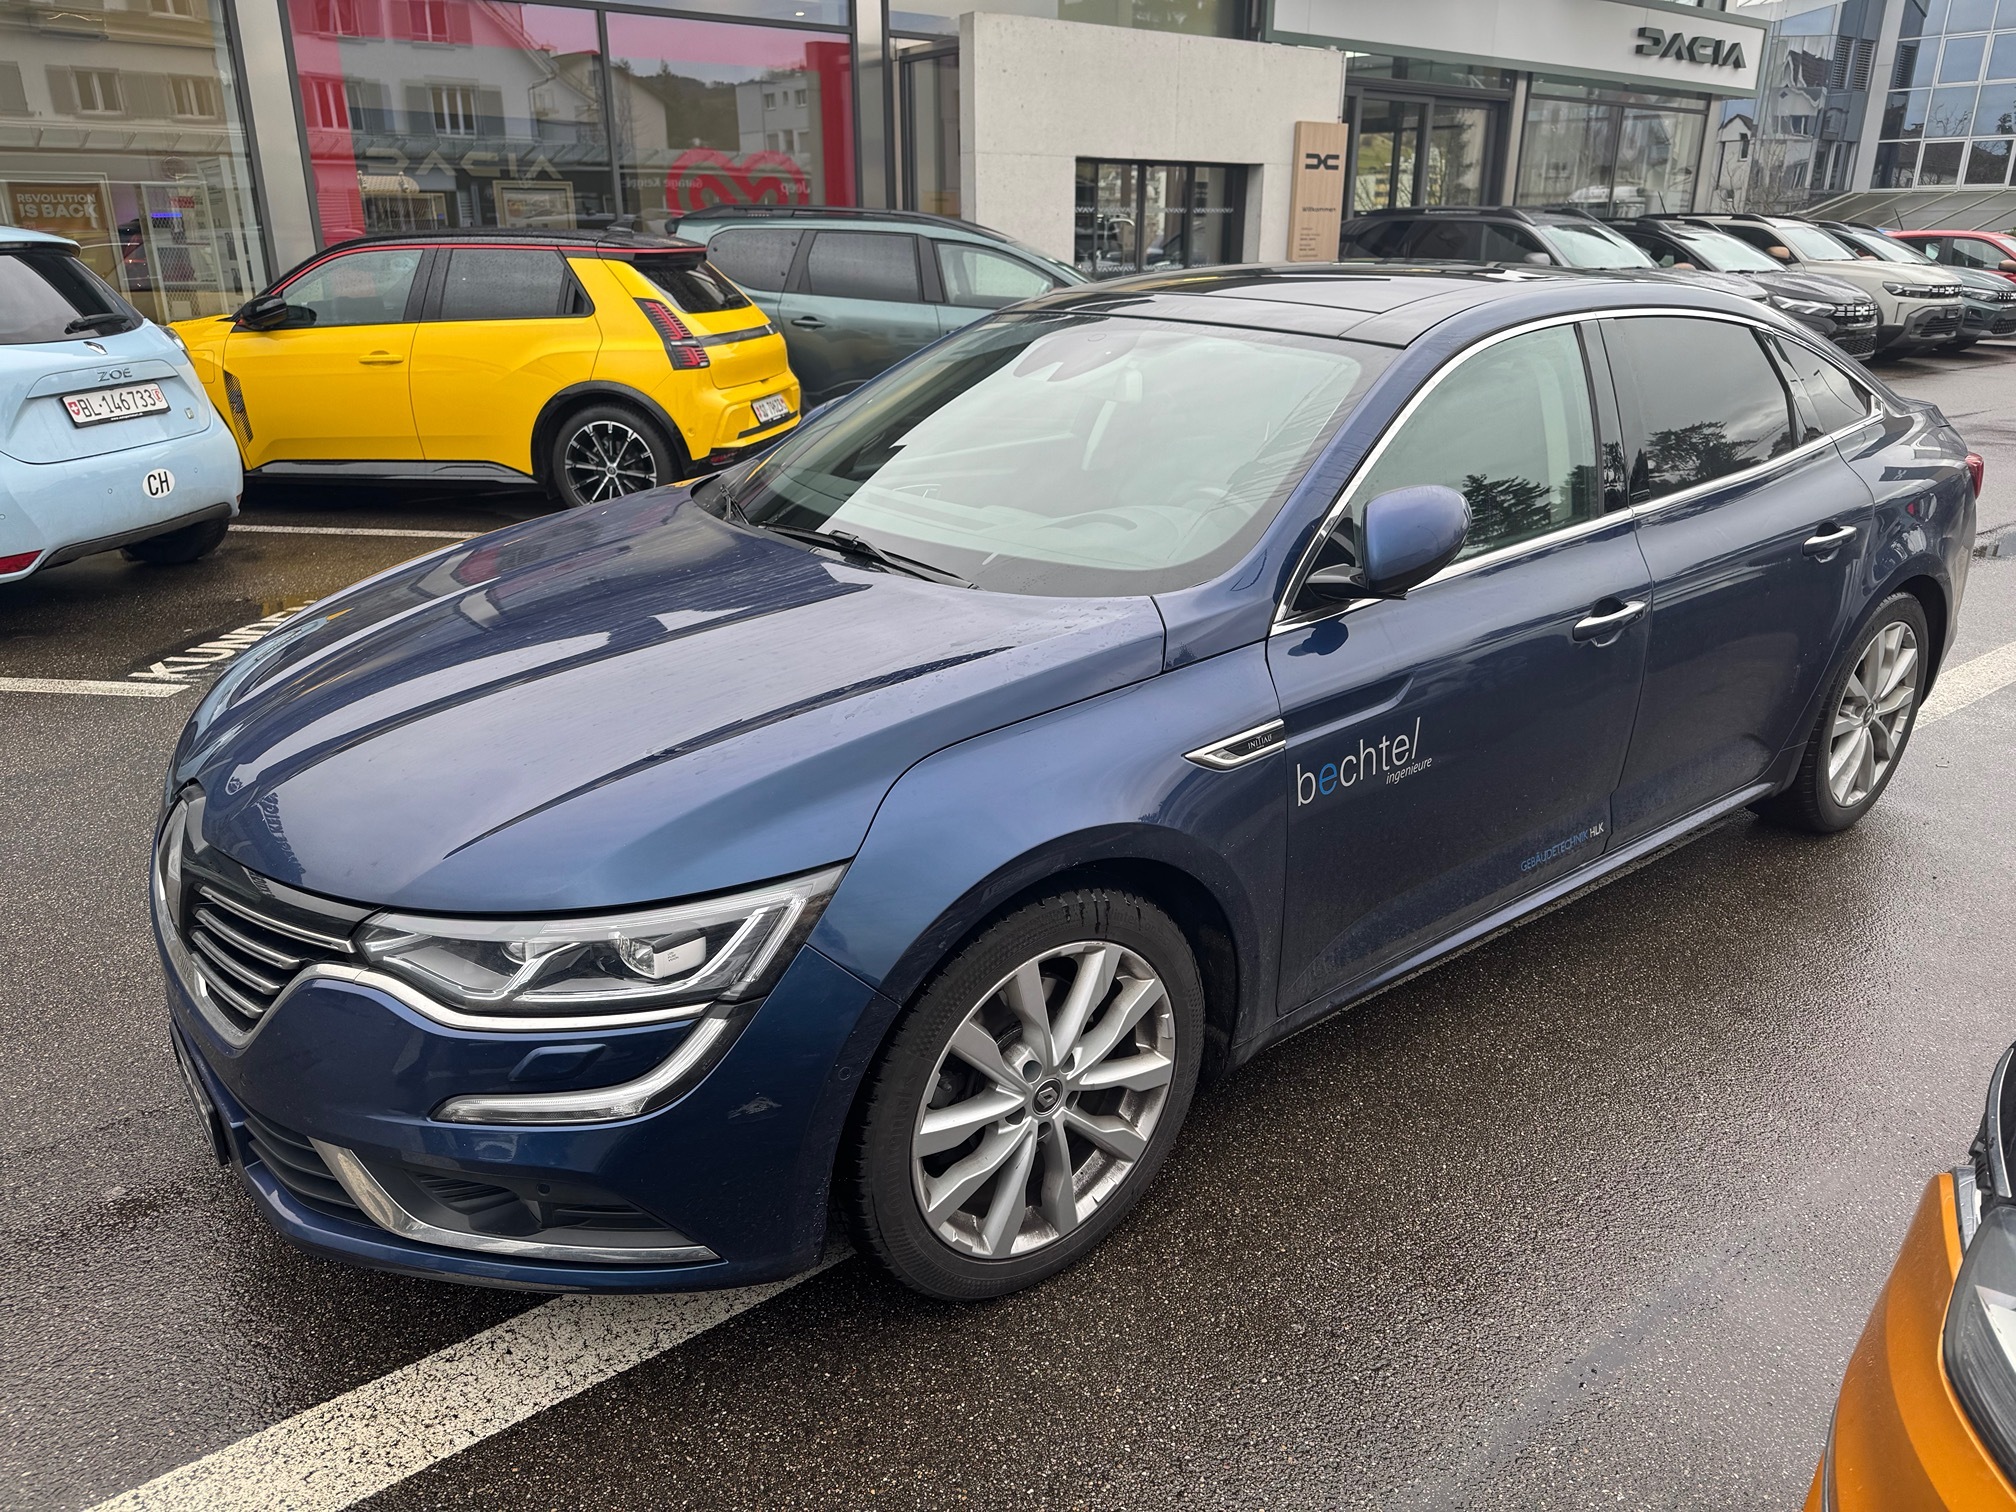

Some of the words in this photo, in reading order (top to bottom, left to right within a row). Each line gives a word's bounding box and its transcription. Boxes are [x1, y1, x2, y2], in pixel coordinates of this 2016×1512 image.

[1635, 26, 1747, 69] DACIA
[364, 147, 564, 181] DACIA
[18, 203, 38, 218] IS
[41, 203, 98, 218] BACK
[97, 367, 133, 382] ZOE
[147, 471, 170, 496] CH
[1296, 716, 1421, 807] bechtel
[1386, 757, 1433, 785] ingenieure
[1520, 829, 1589, 872] GEBÄUDETECHNIK
[1589, 821, 1605, 839] HLK
